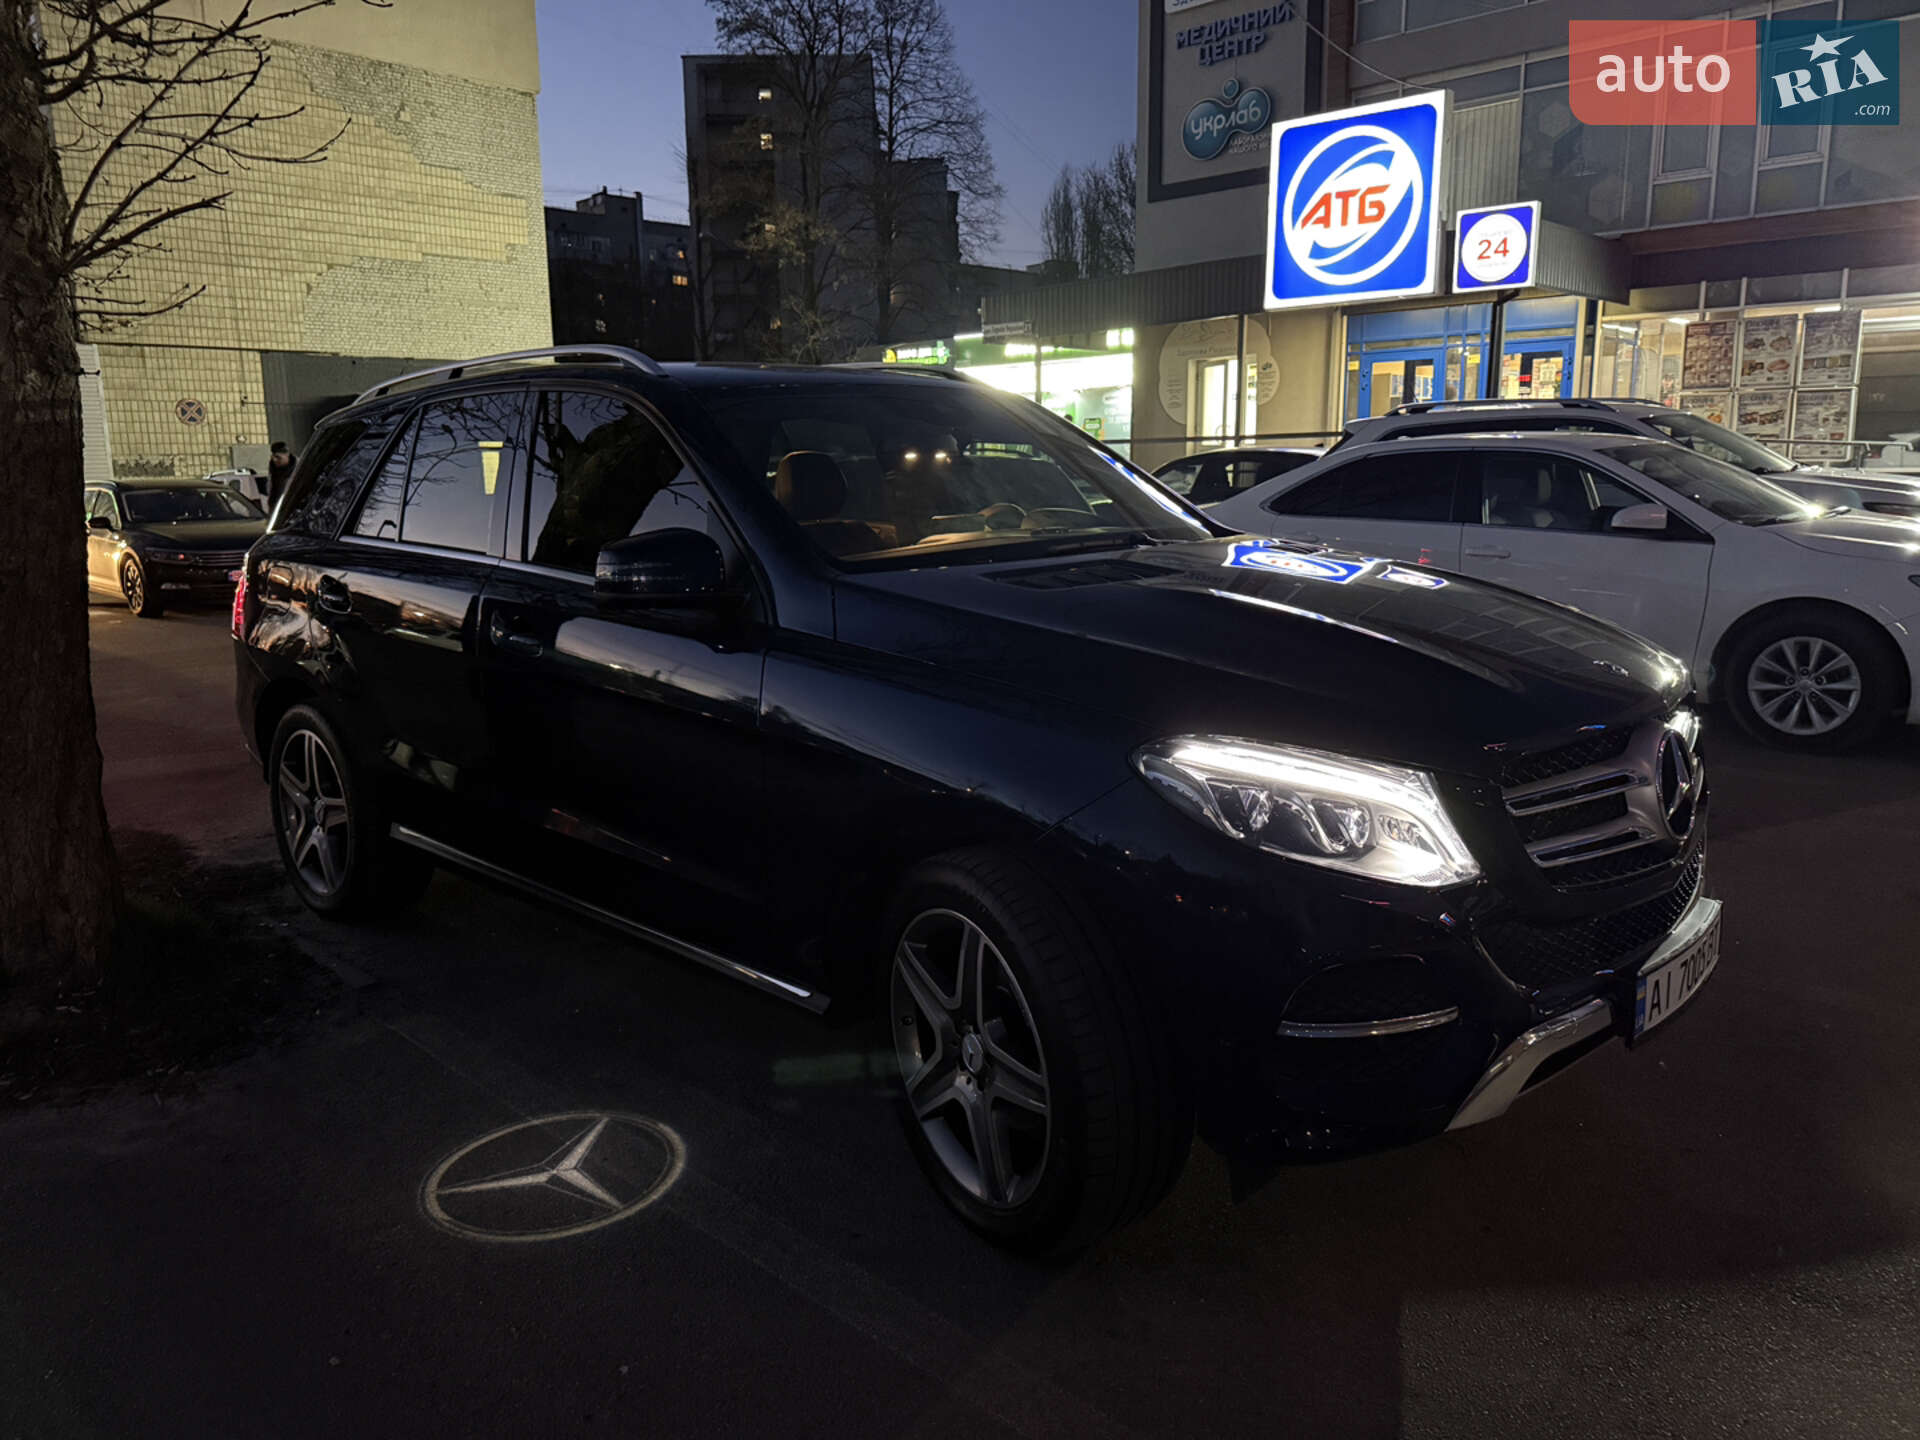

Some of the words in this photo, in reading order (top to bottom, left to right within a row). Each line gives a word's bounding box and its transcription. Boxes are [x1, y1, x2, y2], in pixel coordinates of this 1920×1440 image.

[1176, 0, 1294, 50] МЕДИЧНИЙ
[1198, 31, 1266, 66] ЦЕНТР
[1190, 99, 1262, 140] укрлаб
[1301, 184, 1391, 230] АТБ
[1477, 237, 1510, 260] 24
